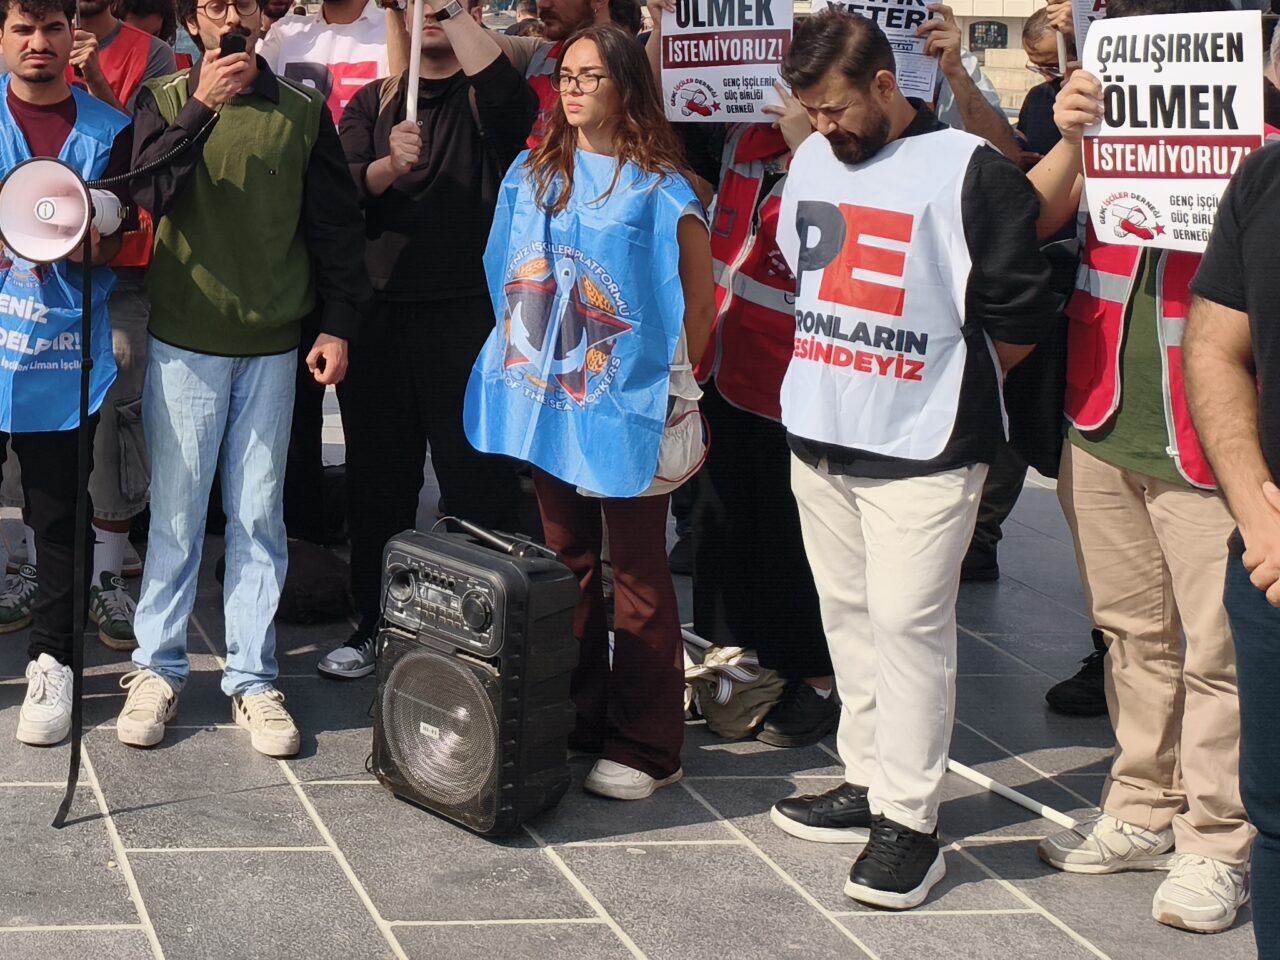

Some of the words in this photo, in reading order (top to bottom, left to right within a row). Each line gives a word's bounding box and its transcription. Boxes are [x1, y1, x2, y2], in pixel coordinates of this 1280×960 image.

[669, 36, 783, 62] İSTEMİYORUZ!
[1097, 32, 1244, 73] ÇALIŞIRKEN
[723, 78, 740, 89] GENÇ
[724, 89, 738, 102] GÜÇ
[739, 89, 763, 100] BİRLİĞİ
[726, 103, 754, 113] DERNEĞİ
[1103, 75, 1239, 130] ÖLMEK
[1103, 191, 1129, 207] İŞÇİLER
[1131, 192, 1162, 219] DERNEĞİ
[1169, 195, 1193, 210] GENÇ
[1171, 209, 1189, 227] GÜÇ
[795, 200, 915, 316] PE
[574, 249, 630, 317] PLATFORMU
[30, 359, 58, 370] Liman
[505, 377, 520, 390] OF
[523, 388, 548, 404] THE
[550, 399, 574, 412] SEA
[576, 356, 621, 410] WORKERS
